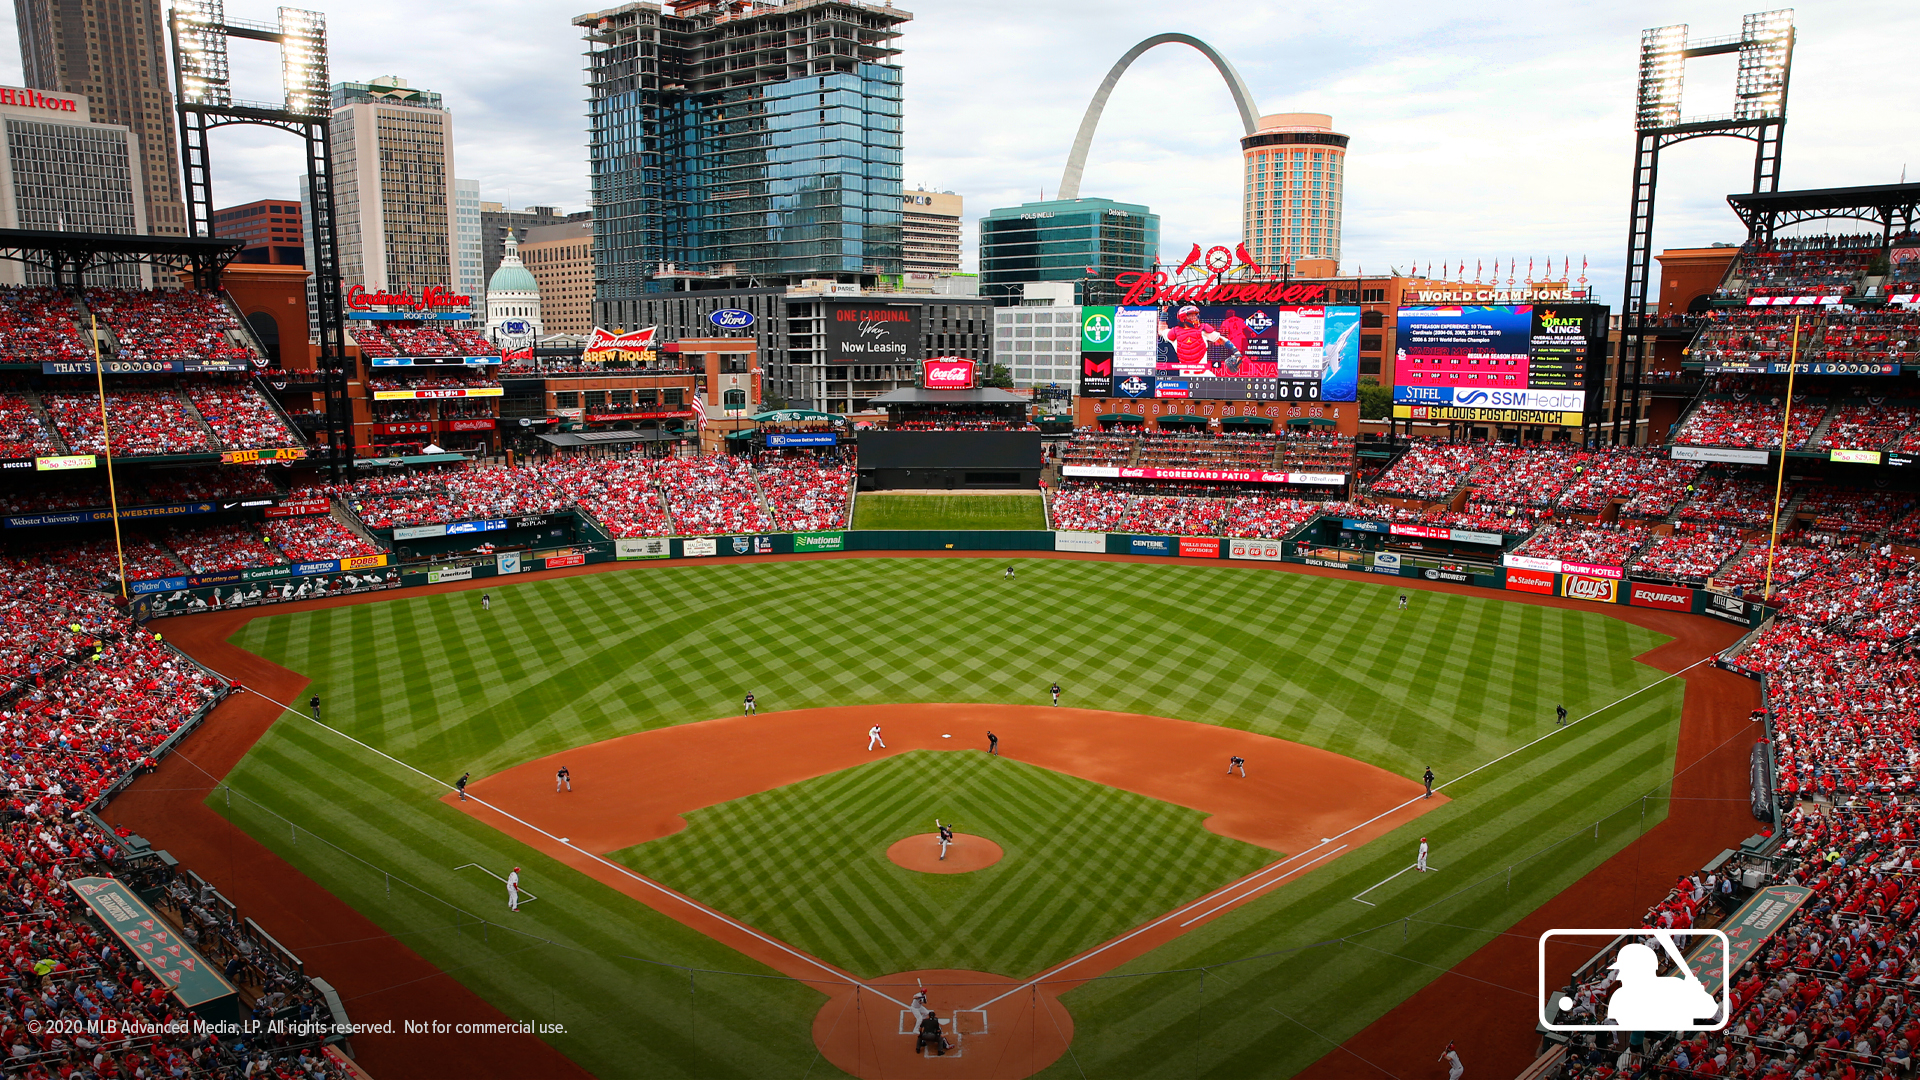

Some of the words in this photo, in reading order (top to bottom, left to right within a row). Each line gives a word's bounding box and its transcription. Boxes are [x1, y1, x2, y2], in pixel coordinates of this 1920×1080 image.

[0, 88, 77, 112] Hilton
[1021, 211, 1055, 219] POLSINELLI
[1115, 272, 1327, 306] Budweiser
[348, 285, 415, 310] Cardinals
[415, 286, 470, 310] Nation
[1418, 290, 1473, 301] WORLD
[1476, 289, 1572, 301] CHAMPIONS
[720, 311, 746, 325] Ford
[836, 310, 857, 321] ONE
[860, 310, 911, 322] CARDINAL
[507, 321, 524, 331] FOX
[1541, 317, 1583, 327] DRAFT
[858, 317, 889, 339] Way
[1546, 325, 1581, 334] KINGS
[497, 338, 535, 347] MIDWEST
[584, 333, 656, 349] Budweiser
[841, 341, 864, 352] Now
[867, 341, 906, 354] Leasing
[502, 347, 533, 361] Live!
[584, 351, 617, 361] BREW
[619, 351, 656, 361] HOUSE
[54, 363, 91, 373] THAT'S
[111, 361, 162, 372] POWER
[1814, 364, 1821, 373] A
[1826, 363, 1881, 374] POWER
[929, 368, 967, 380] Coca-Cola
[1280, 386, 1288, 398] 0
[1294, 386, 1302, 398] 0
[1309, 386, 1317, 398] 0
[1406, 386, 1440, 399] STIFEL
[1491, 391, 1582, 408] SSMHealth
[1112, 404, 1116, 413] 1
[1123, 403, 1130, 413] 2
[1138, 404, 1144, 414] 6
[1152, 404, 1159, 414] 9
[1167, 404, 1177, 414] 10
[1185, 405, 1195, 415] 14
[1204, 405, 1214, 415] 17
[1222, 405, 1235, 416] 20
[1243, 406, 1257, 416] 24
[1265, 406, 1279, 417] 42
[1287, 407, 1301, 417] 45
[1309, 407, 1323, 418] 85
[1413, 408, 1427, 416] stl
[1431, 407, 1445, 418] ST.
[1447, 408, 1476, 419] LOUIS
[1480, 408, 1562, 424] POST-DISPATCH
[231, 450, 259, 463] BIG
[63, 458, 92, 467] $29,575
[1156, 470, 1218, 479] SCOREBOARD
[1221, 472, 1250, 480] PATIO
[290, 506, 305, 515] 210
[10, 518, 41, 526] Webster
[42, 514, 80, 524] University
[1354, 522, 1378, 531] neighbors
[807, 536, 841, 545] National
[1234, 547, 1244, 555] 66
[350, 556, 378, 565] DOBBS
[1305, 558, 1323, 567] BUSCH
[1324, 561, 1348, 570] STADIUM
[1381, 555, 1395, 563] Ford
[298, 562, 334, 571] ATHLETICO
[1563, 564, 1590, 574] DRURY
[1591, 566, 1621, 577] HOTELS
[251, 569, 275, 577] Central
[276, 568, 291, 576] Bank
[441, 570, 471, 578] Ameritrade
[1440, 572, 1467, 581] MIDWEST
[133, 579, 171, 593] Children's
[1568, 575, 1609, 598] Lay's
[1634, 590, 1686, 604] EQUIFAX
[1753, 901, 1789, 930] CHAMPIONS
